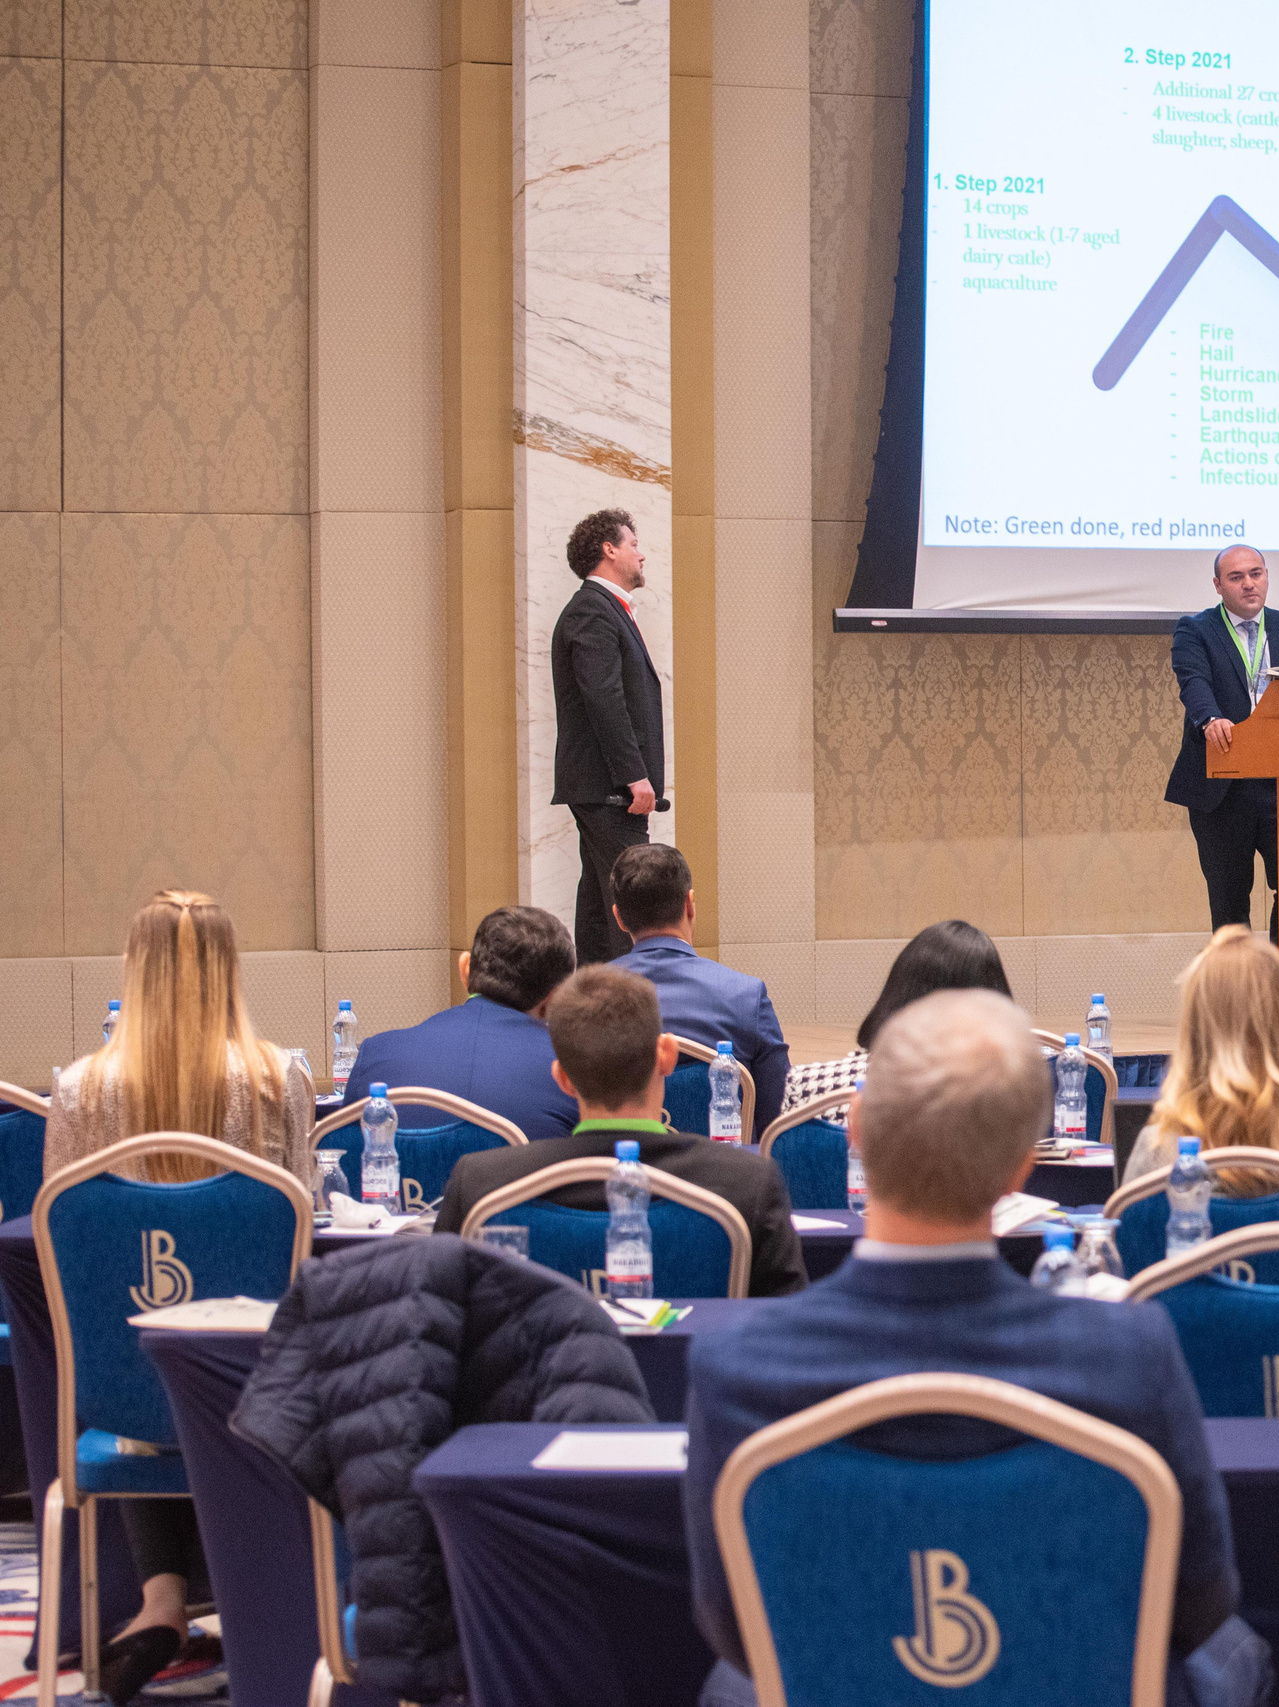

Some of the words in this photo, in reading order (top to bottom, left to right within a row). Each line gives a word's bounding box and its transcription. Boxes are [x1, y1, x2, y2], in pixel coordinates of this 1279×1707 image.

[1124, 47, 1138, 63] 2.
[1146, 49, 1185, 70] Step
[1192, 52, 1230, 69] 2021
[1153, 81, 1232, 99] Additional
[1237, 85, 1255, 101] 27
[1153, 105, 1161, 120] 4
[1166, 105, 1232, 124] livestock
[1153, 129, 1227, 152] slaughter,
[1230, 133, 1277, 155] sheep,
[934, 173, 948, 189] 1.
[955, 174, 997, 196] Step
[1004, 176, 1043, 193] 2021
[964, 198, 982, 213] 14
[986, 204, 1028, 220] crops
[964, 224, 971, 238] 1
[977, 223, 1046, 241] livestock
[1050, 226, 1079, 245] (1-7
[1083, 228, 1120, 250] aged
[963, 247, 1003, 270] dairy
[1008, 249, 1051, 269] catle)
[963, 274, 1057, 294] aquaculture
[1200, 323, 1234, 340] Fire
[1200, 344, 1233, 361] Hail
[1200, 386, 1253, 402] Storm
[1200, 447, 1268, 464] Actions
[946, 515, 997, 533] Note:
[1005, 516, 1063, 534] Green
[1070, 516, 1126, 540] done,
[1132, 518, 1162, 536] red
[1169, 517, 1245, 543] planned
